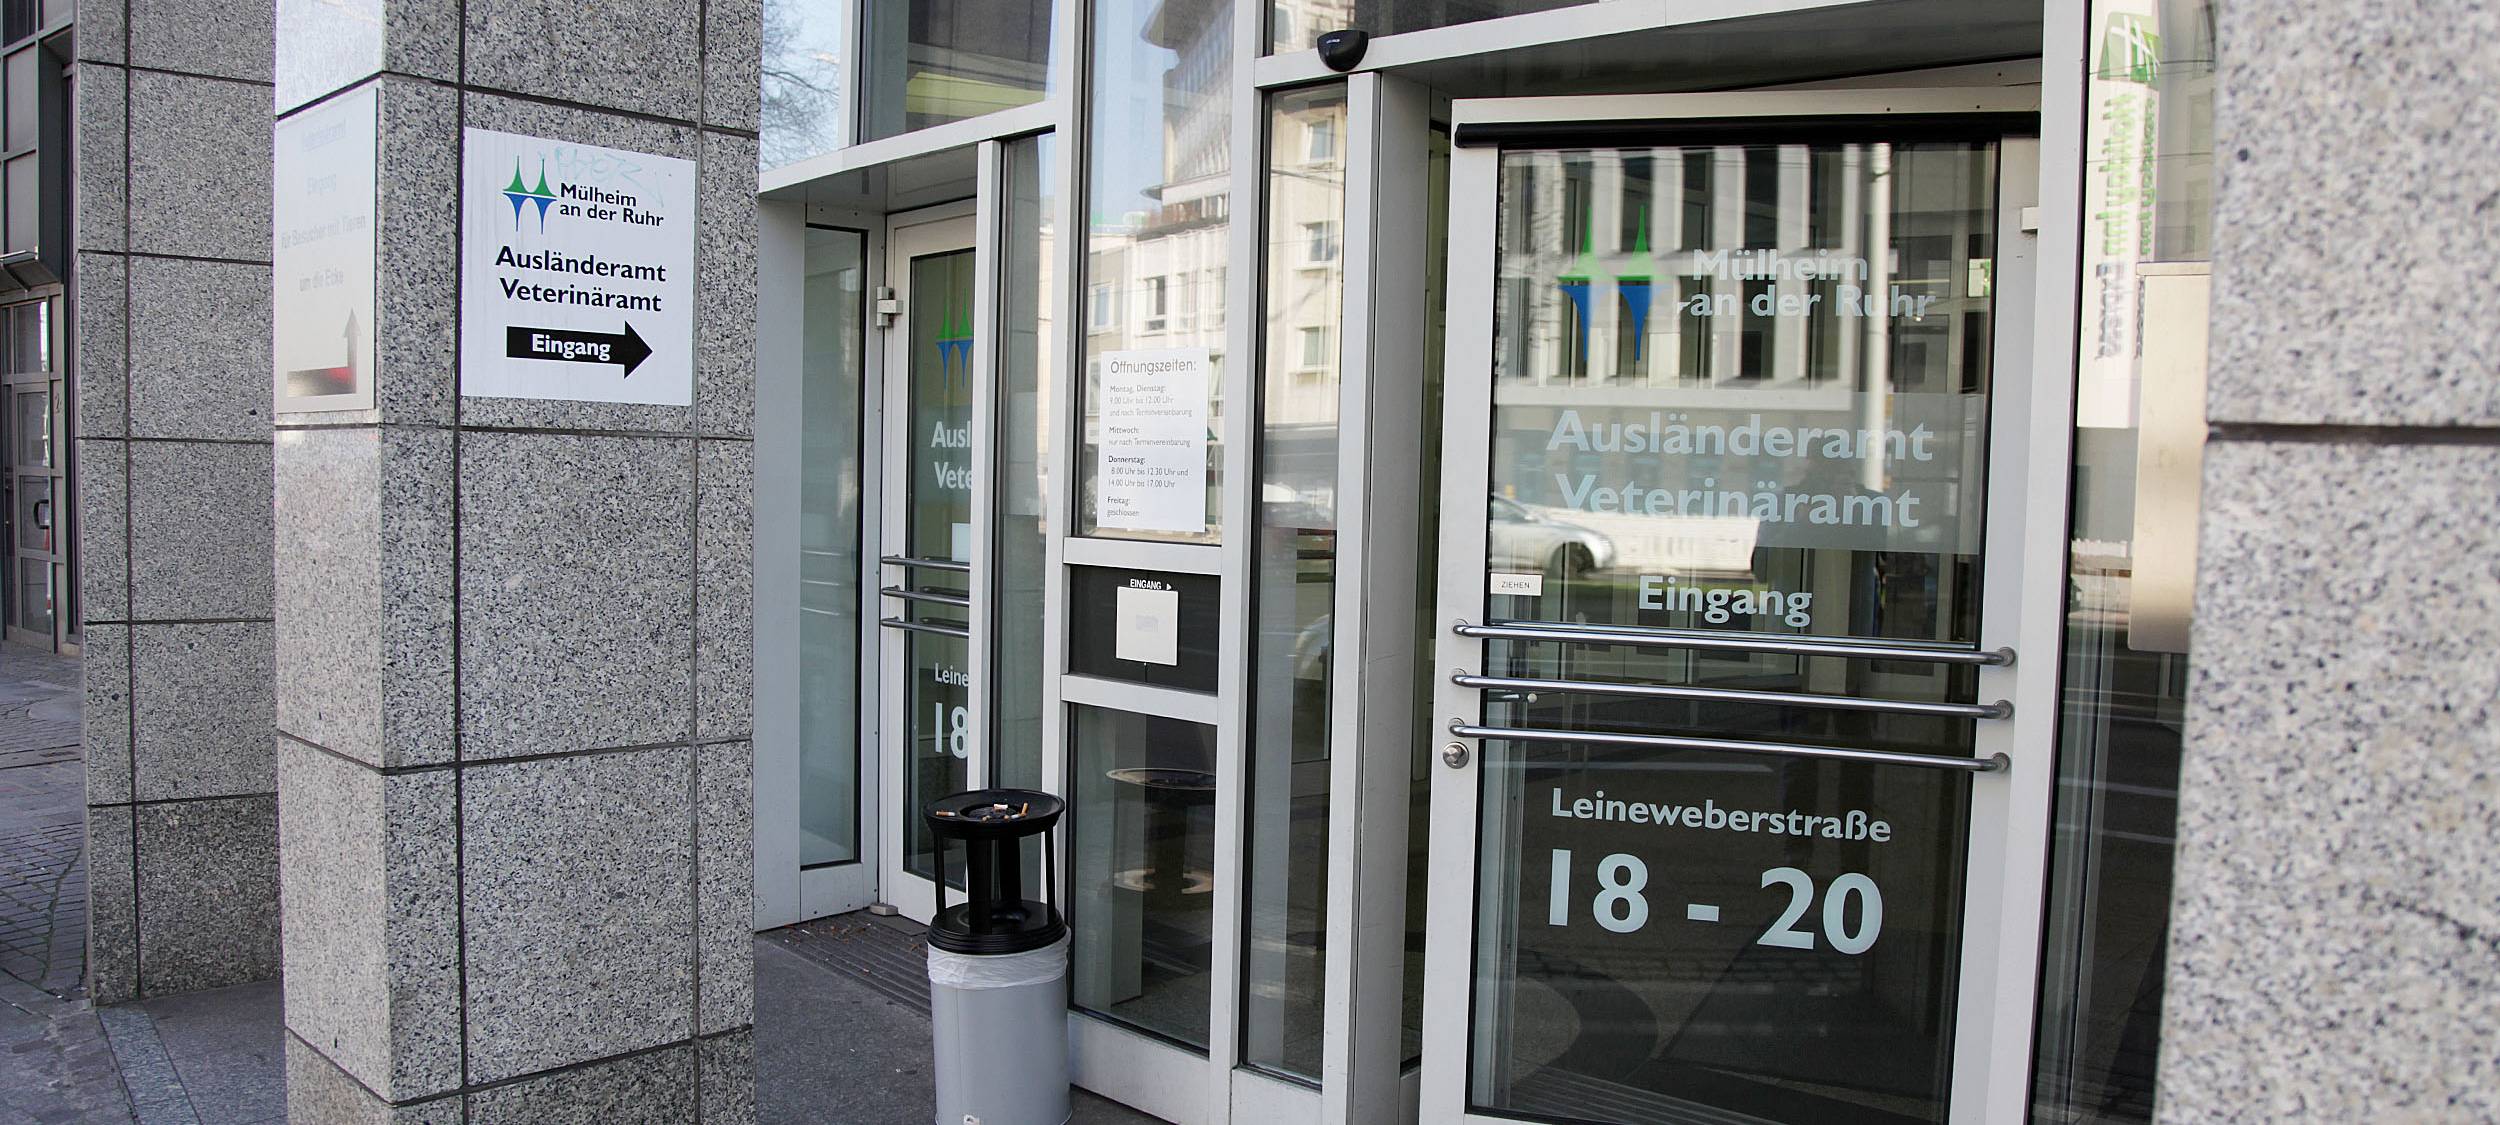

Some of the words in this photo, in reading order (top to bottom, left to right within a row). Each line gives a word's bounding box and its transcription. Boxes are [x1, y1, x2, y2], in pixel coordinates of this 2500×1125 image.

[560, 183, 637, 207] Mülheim
[560, 204, 581, 217] an
[587, 204, 617, 221] der
[623, 208, 664, 227] Ruhr
[495, 245, 667, 282] Ausländeramt
[1693, 248, 1868, 281] Mülheim
[499, 277, 662, 312] Veterinäramt
[1690, 292, 1736, 317] an
[1751, 284, 1821, 317] der
[1835, 284, 1937, 318] Ruhr
[531, 333, 611, 361] Eingang
[1110, 356, 1197, 376] Öffnungszeiten:
[1546, 409, 1934, 462] Ausländeramt
[1555, 473, 1921, 528] Veterinäramt
[1129, 578, 1162, 590] EINGANG
[1501, 581, 1531, 589] ZIEHEN
[1638, 574, 1813, 628] Eingang
[935, 702, 968, 759] 18
[1552, 787, 1891, 842] Leineweberstraße
[1549, 848, 1650, 934] 18
[1756, 866, 1884, 955] 20
